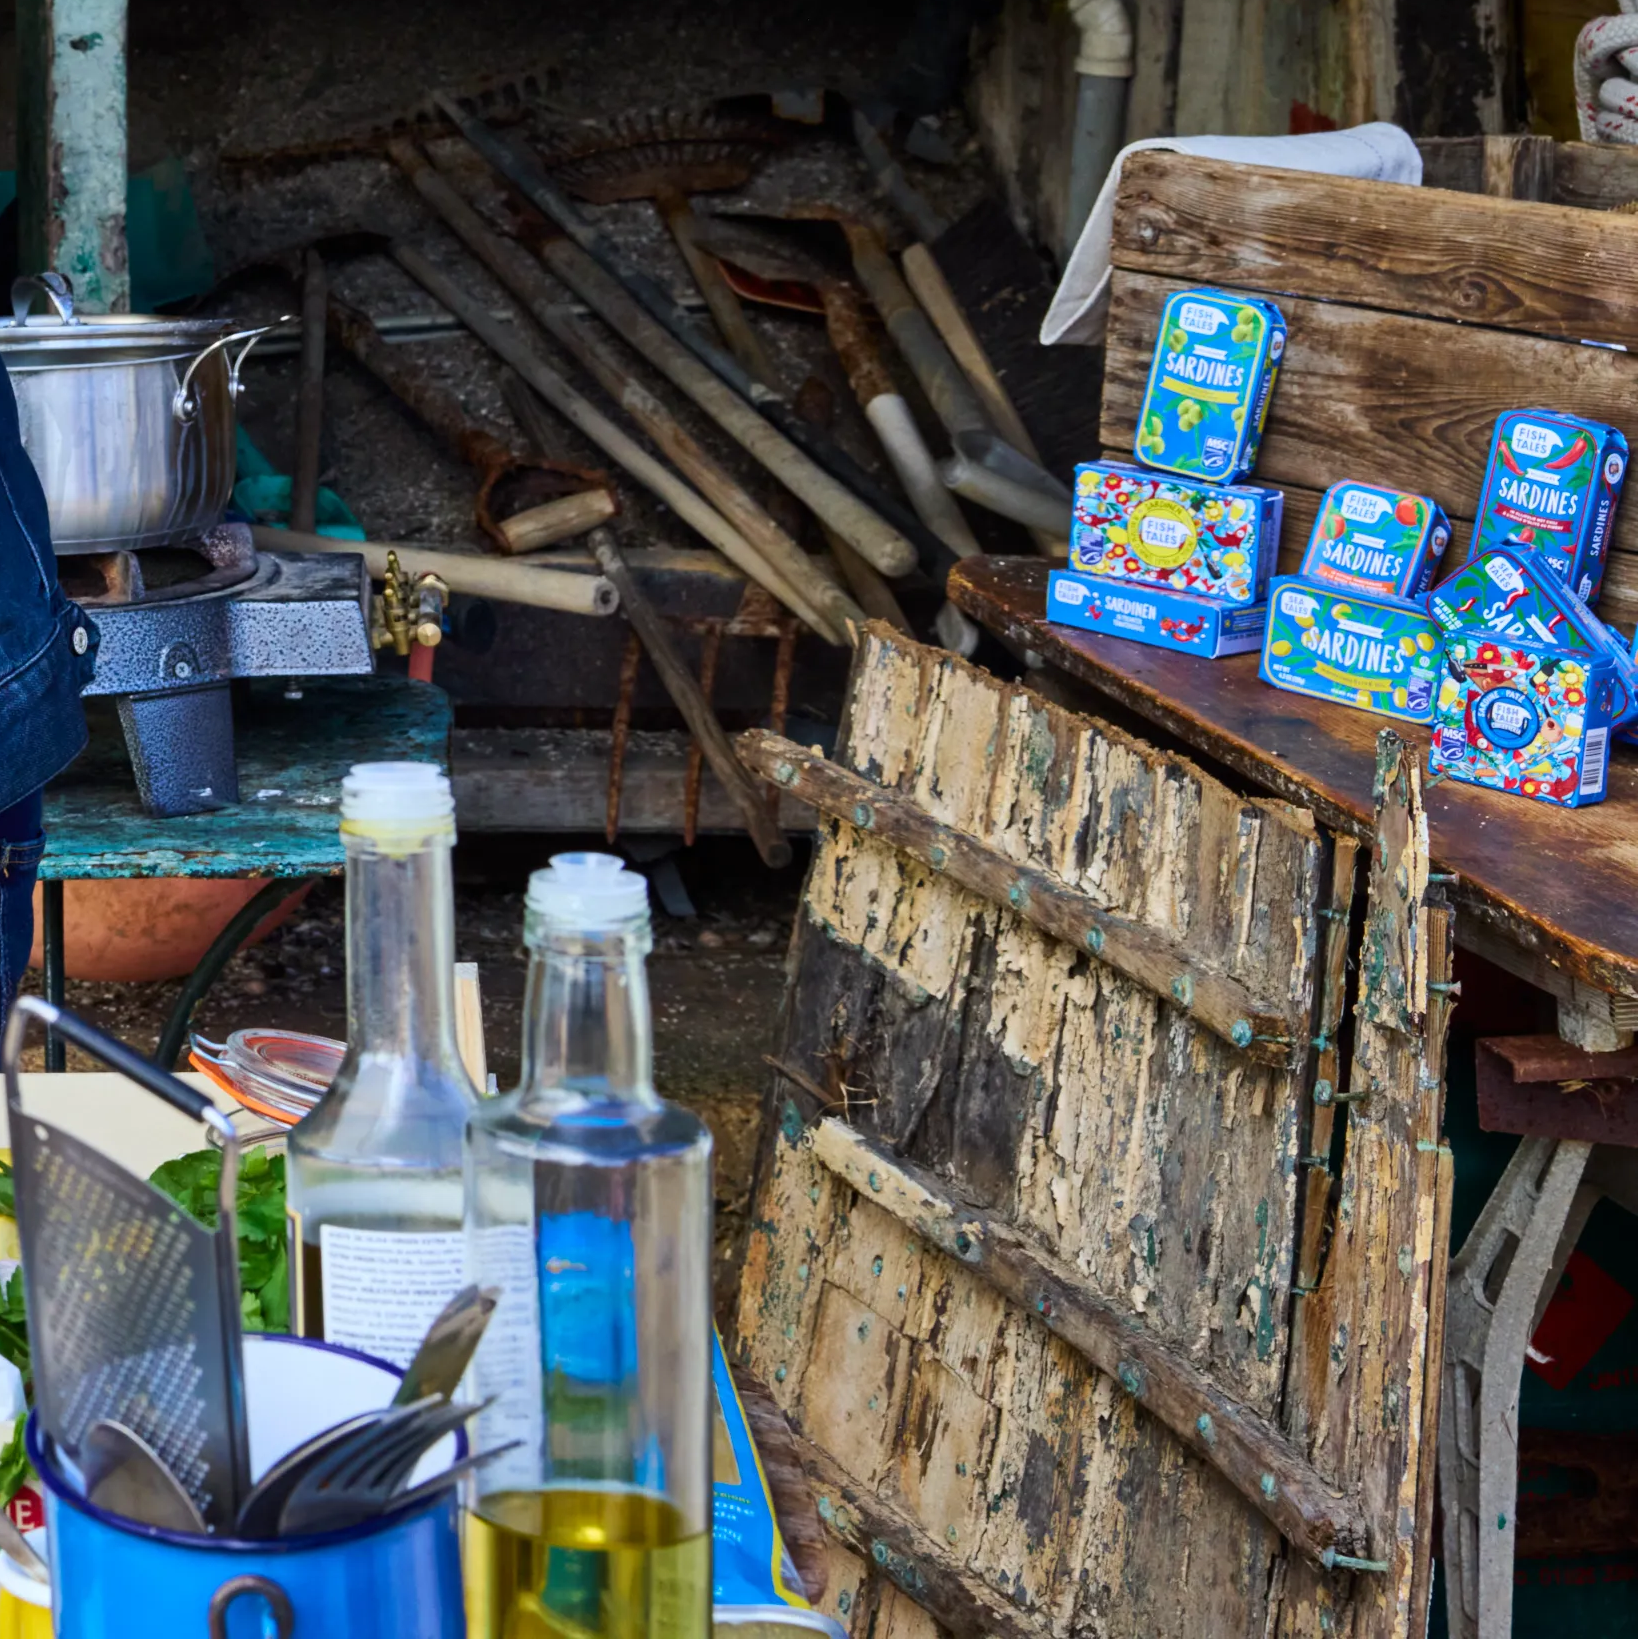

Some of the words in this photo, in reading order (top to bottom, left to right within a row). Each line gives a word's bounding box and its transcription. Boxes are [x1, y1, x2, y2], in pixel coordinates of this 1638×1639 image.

[1186, 306, 1213, 321] FISH
[1183, 316, 1215, 332] TALES
[1165, 352, 1244, 386] SARDINES
[1519, 427, 1547, 442] FISH
[1206, 437, 1229, 451] MSC
[1516, 438, 1547, 454] TALES
[1349, 495, 1378, 509] FISH
[1498, 477, 1578, 515] SARDINES
[1346, 505, 1376, 520] TALES
[1148, 520, 1175, 532] FISH
[1590, 500, 1610, 557] SARDINES
[1145, 530, 1177, 545] TALES
[1323, 539, 1403, 577] SARDINES
[1489, 564, 1511, 588] TALES
[1498, 563, 1513, 579] SEA
[1059, 582, 1079, 592] FISH
[1058, 590, 1080, 601] TALES
[1288, 595, 1305, 605] SEA
[1104, 595, 1157, 620] SARDINEN
[1284, 603, 1308, 616] TALES
[1308, 626, 1405, 673] SARDINES
[1497, 704, 1519, 716] FISH
[1495, 713, 1520, 725] TALES
[1443, 727, 1466, 741] MSC
